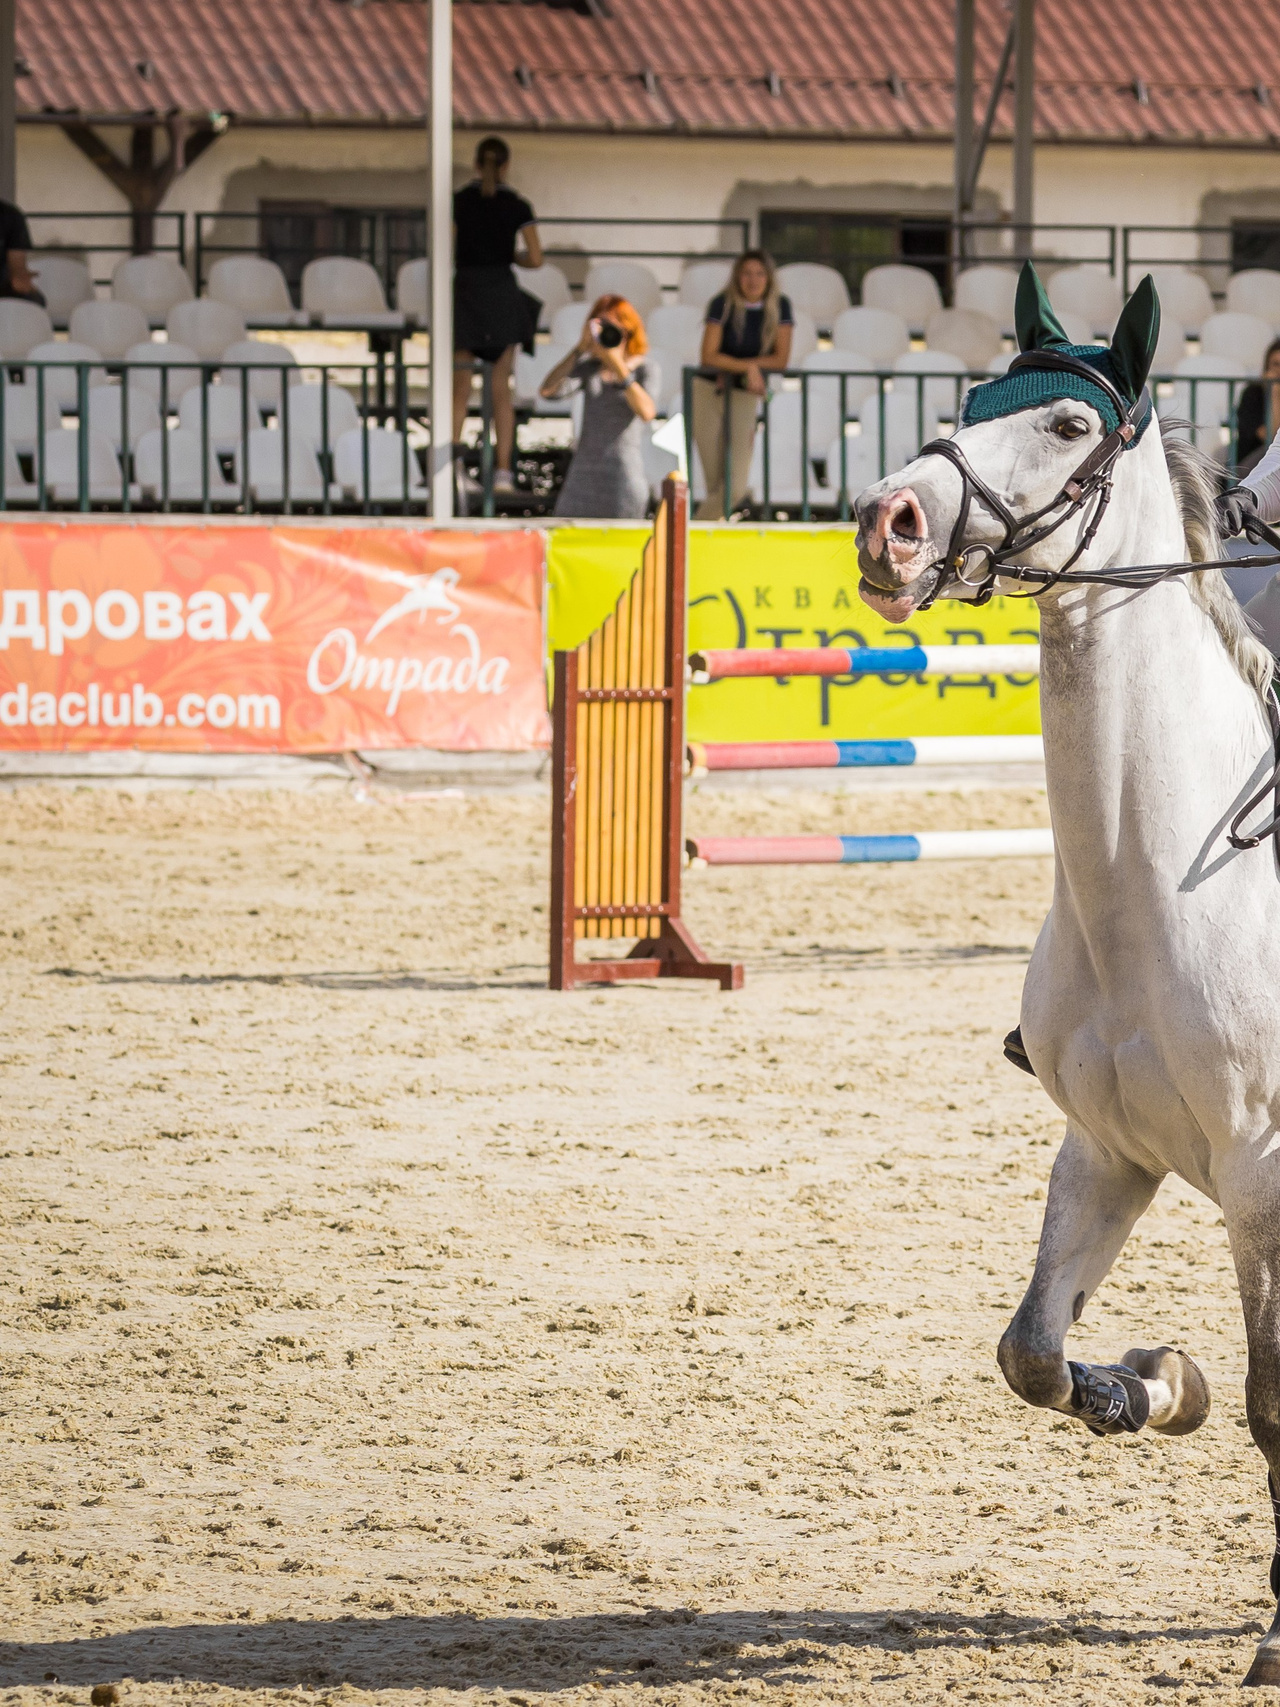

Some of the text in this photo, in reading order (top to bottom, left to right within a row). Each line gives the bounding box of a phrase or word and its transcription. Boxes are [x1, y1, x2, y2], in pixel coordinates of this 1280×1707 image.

[0, 589, 272, 655] дровах
[307, 624, 510, 717] Отрада
[0, 682, 281, 729] daclub.com
